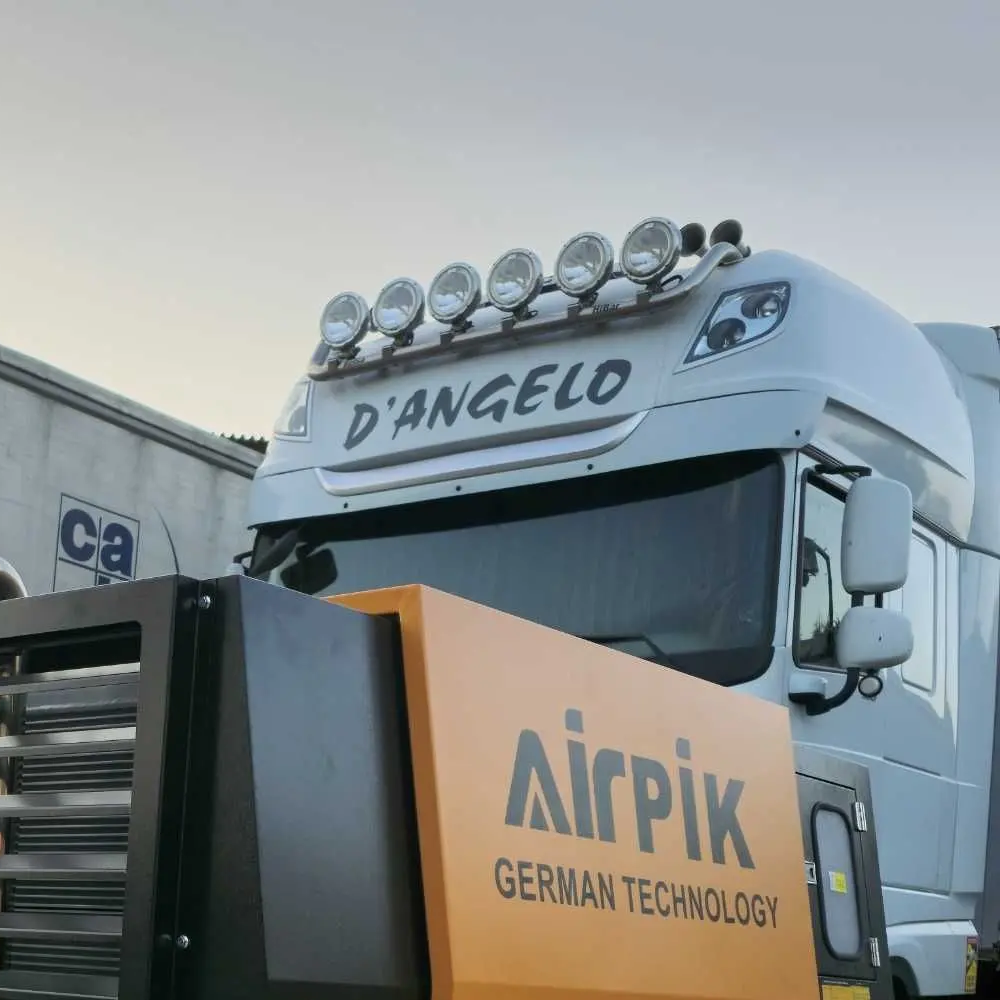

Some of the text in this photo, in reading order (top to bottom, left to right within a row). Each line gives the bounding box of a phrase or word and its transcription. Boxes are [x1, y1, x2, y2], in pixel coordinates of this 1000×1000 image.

[343, 359, 632, 450] D'ANGELO
[494, 857, 779, 929] GERMAN TECHNOLOGY
